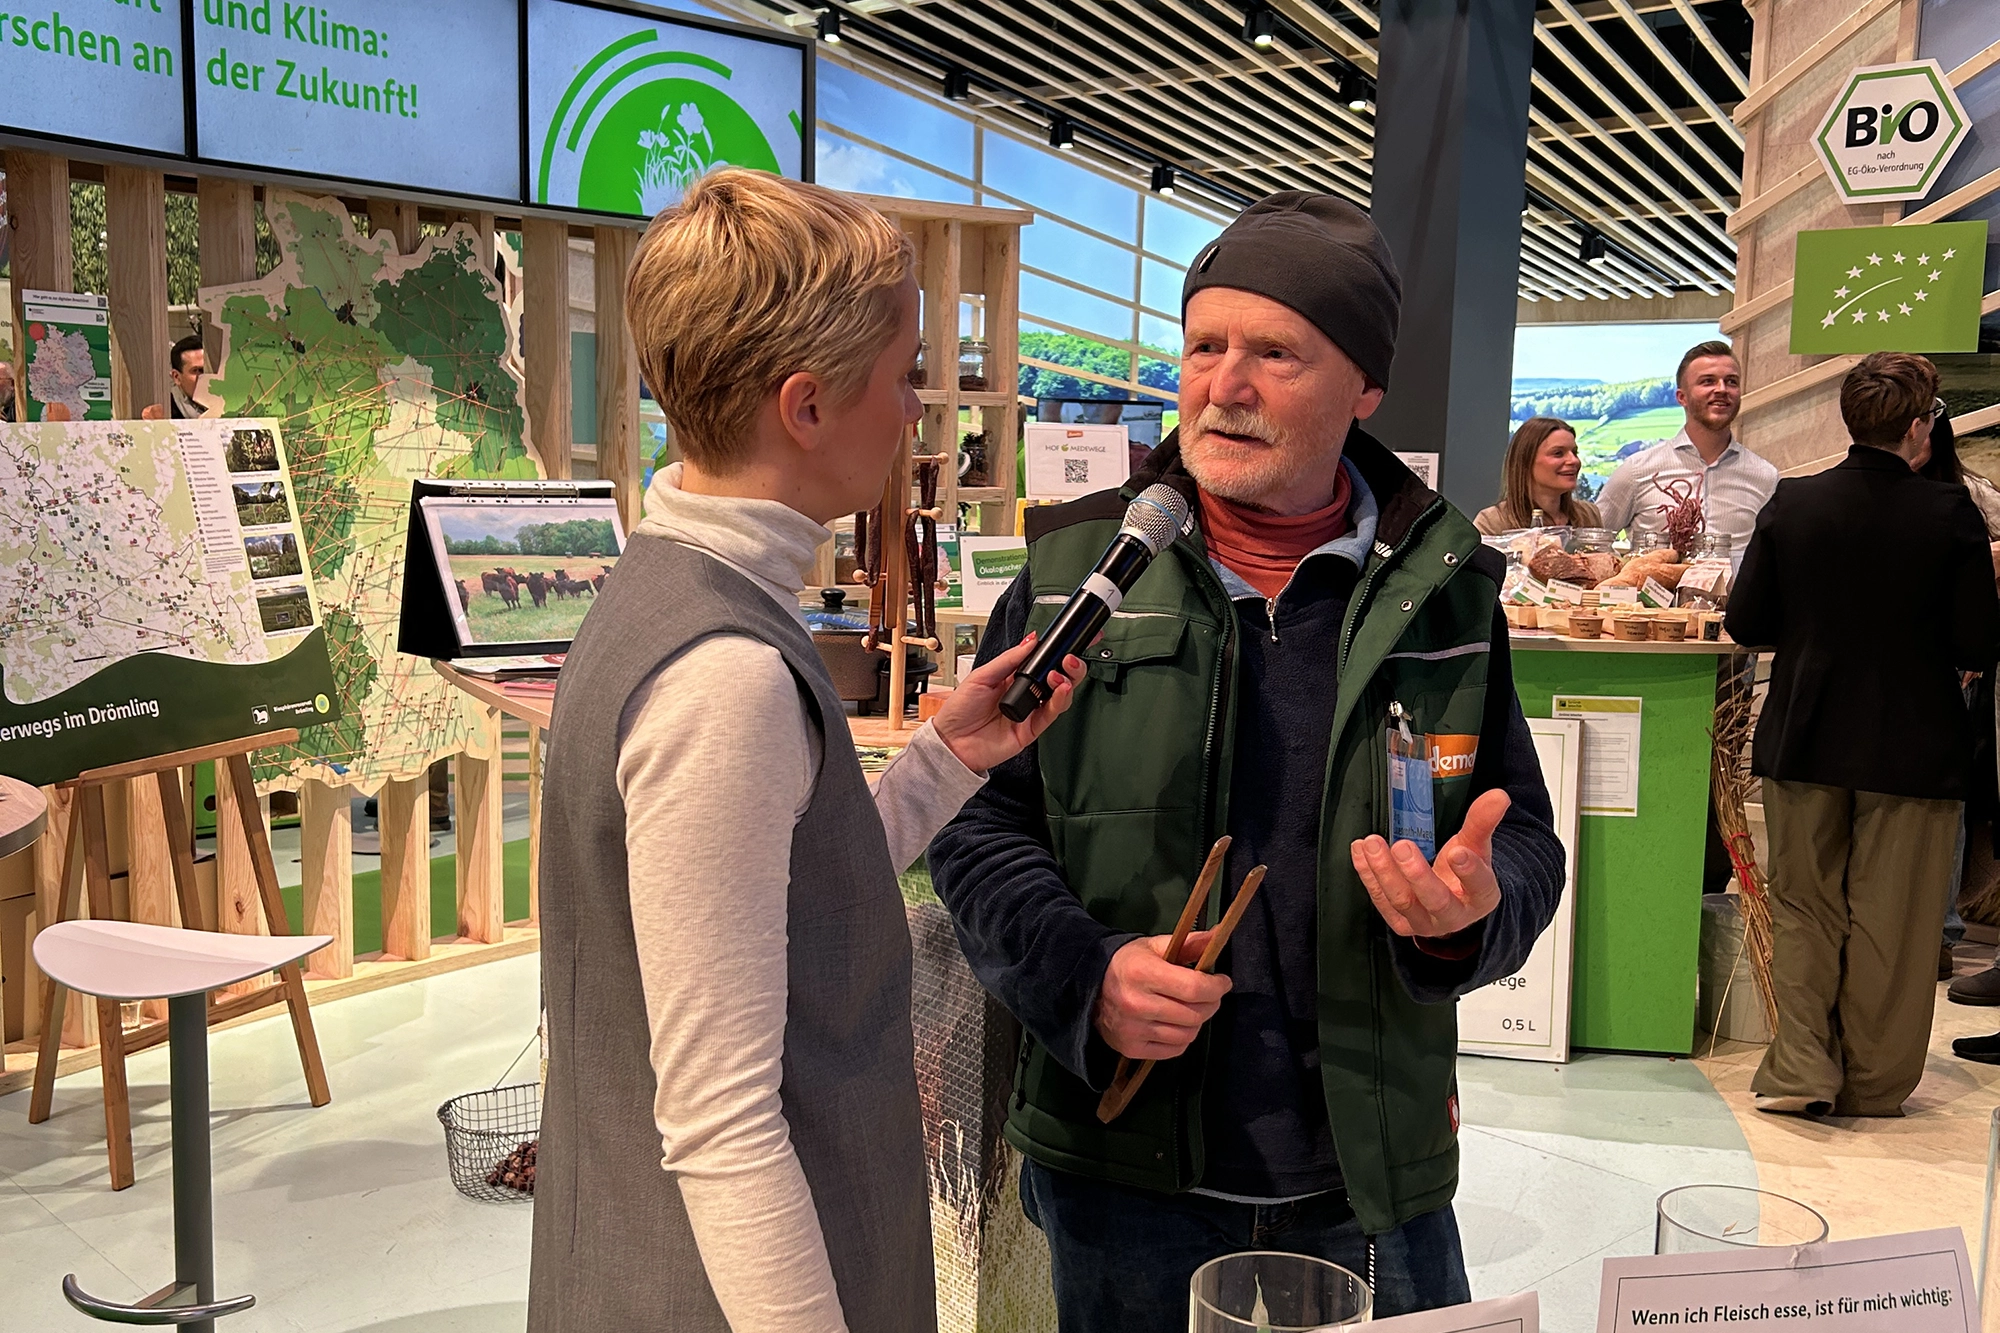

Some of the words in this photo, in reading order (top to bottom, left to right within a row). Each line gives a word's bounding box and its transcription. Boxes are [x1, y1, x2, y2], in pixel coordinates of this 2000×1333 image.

[203, 0, 271, 35] und
[283, 2, 388, 58] Klima:
[133, 42, 173, 77] an
[206, 47, 265, 92] der
[275, 59, 418, 119] Zukunft!
[1876, 150, 1896, 160] nach
[1847, 161, 1924, 176] EG-Öko-Verordnung
[1045, 444, 1060, 452] HOF
[63, 711, 87, 730] im
[88, 698, 160, 725] Drömling
[1528, 1020, 1536, 1032] L
[1631, 1308, 1680, 1326] Wenn
[1684, 1307, 1709, 1324] ich
[1713, 1303, 1770, 1322] Fleisch
[1774, 1306, 1812, 1320] esse,
[1815, 1299, 1834, 1316] ist
[1837, 1296, 1860, 1314] für
[1863, 1292, 1898, 1312] mich
[1899, 1287, 1953, 1308] wichtig:
